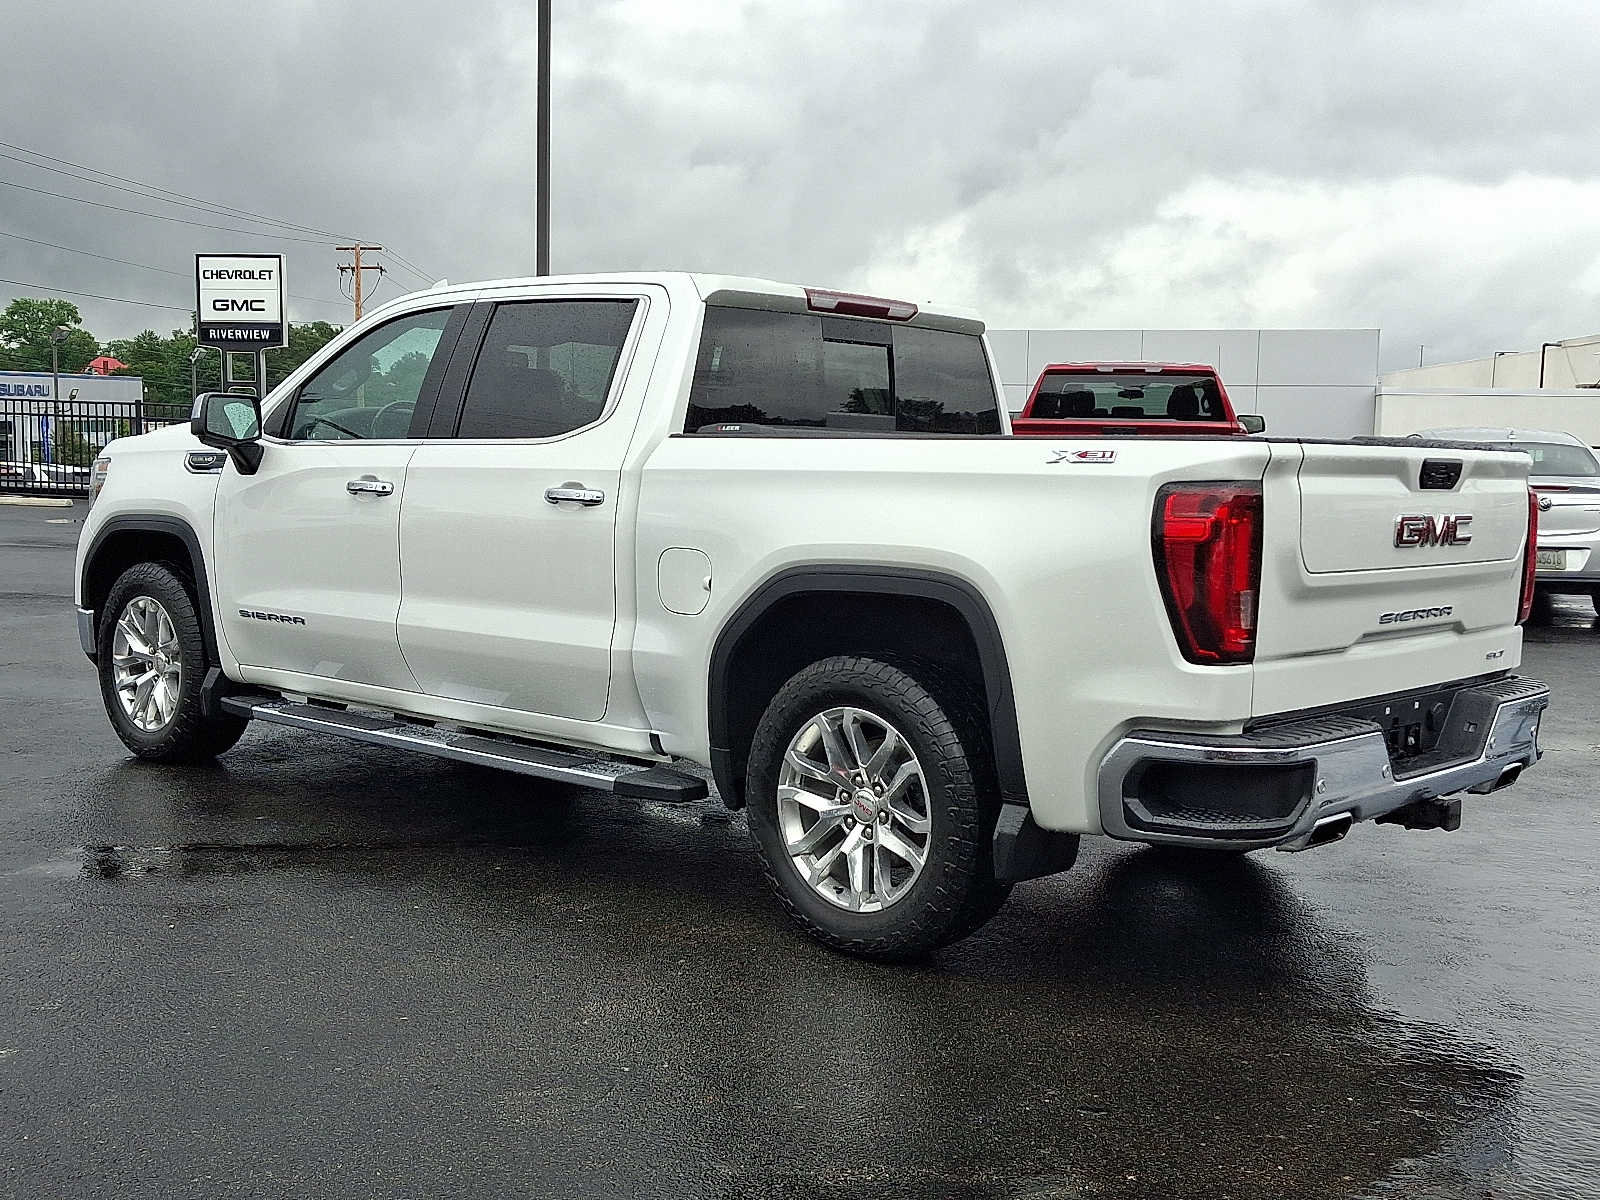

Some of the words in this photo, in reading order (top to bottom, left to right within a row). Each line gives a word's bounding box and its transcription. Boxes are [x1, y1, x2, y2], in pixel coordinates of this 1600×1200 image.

[202, 269, 274, 281] CHEVROLET
[212, 299, 266, 312] GMC
[209, 329, 270, 340] RIVERVIEW
[0, 383, 50, 397] SUBARU
[1393, 513, 1473, 548] GMC
[238, 609, 305, 625] SIERRA
[1378, 606, 1453, 625] SIERRA
[855, 800, 873, 816] GMC
